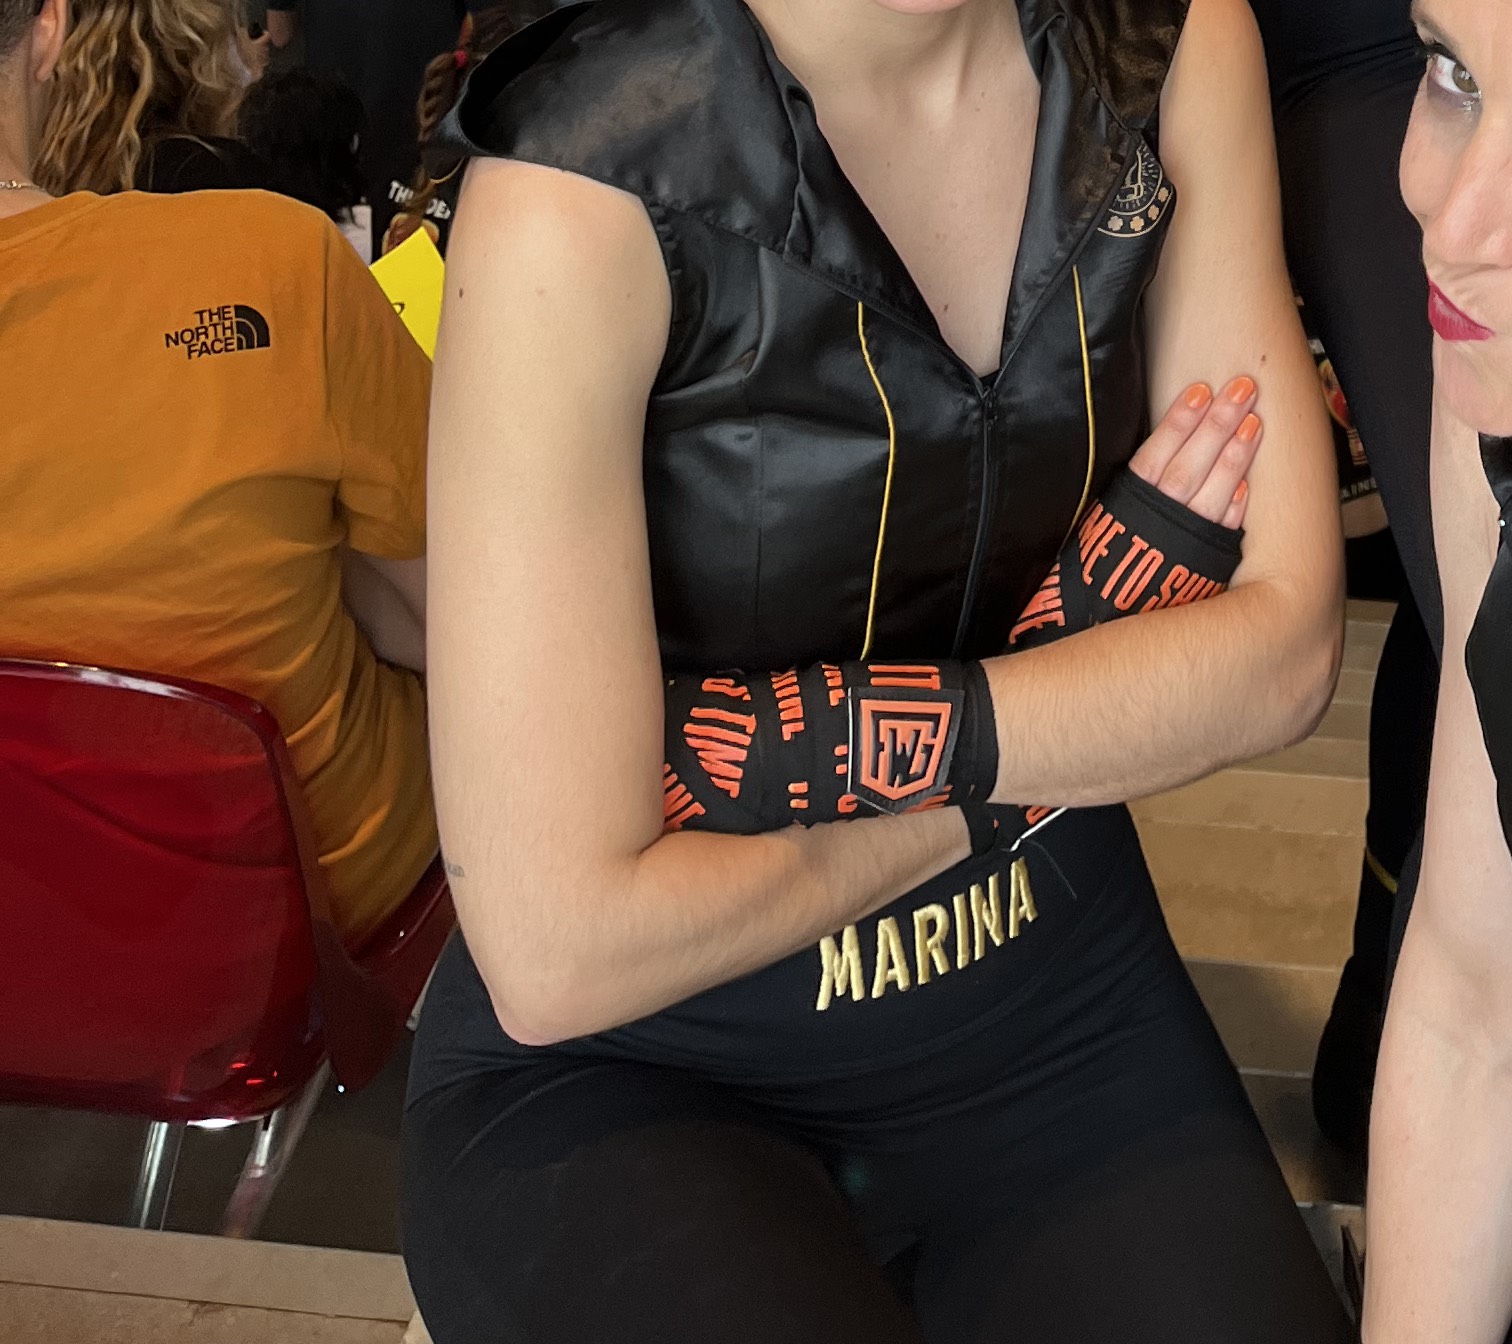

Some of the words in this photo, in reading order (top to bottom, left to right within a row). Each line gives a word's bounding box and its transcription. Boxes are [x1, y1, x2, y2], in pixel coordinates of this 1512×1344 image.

[194, 305, 233, 325] THE
[164, 321, 234, 348] NORTH
[187, 337, 235, 359] FACE
[1100, 534, 1165, 611] TO
[815, 856, 1038, 1011] MARINA
